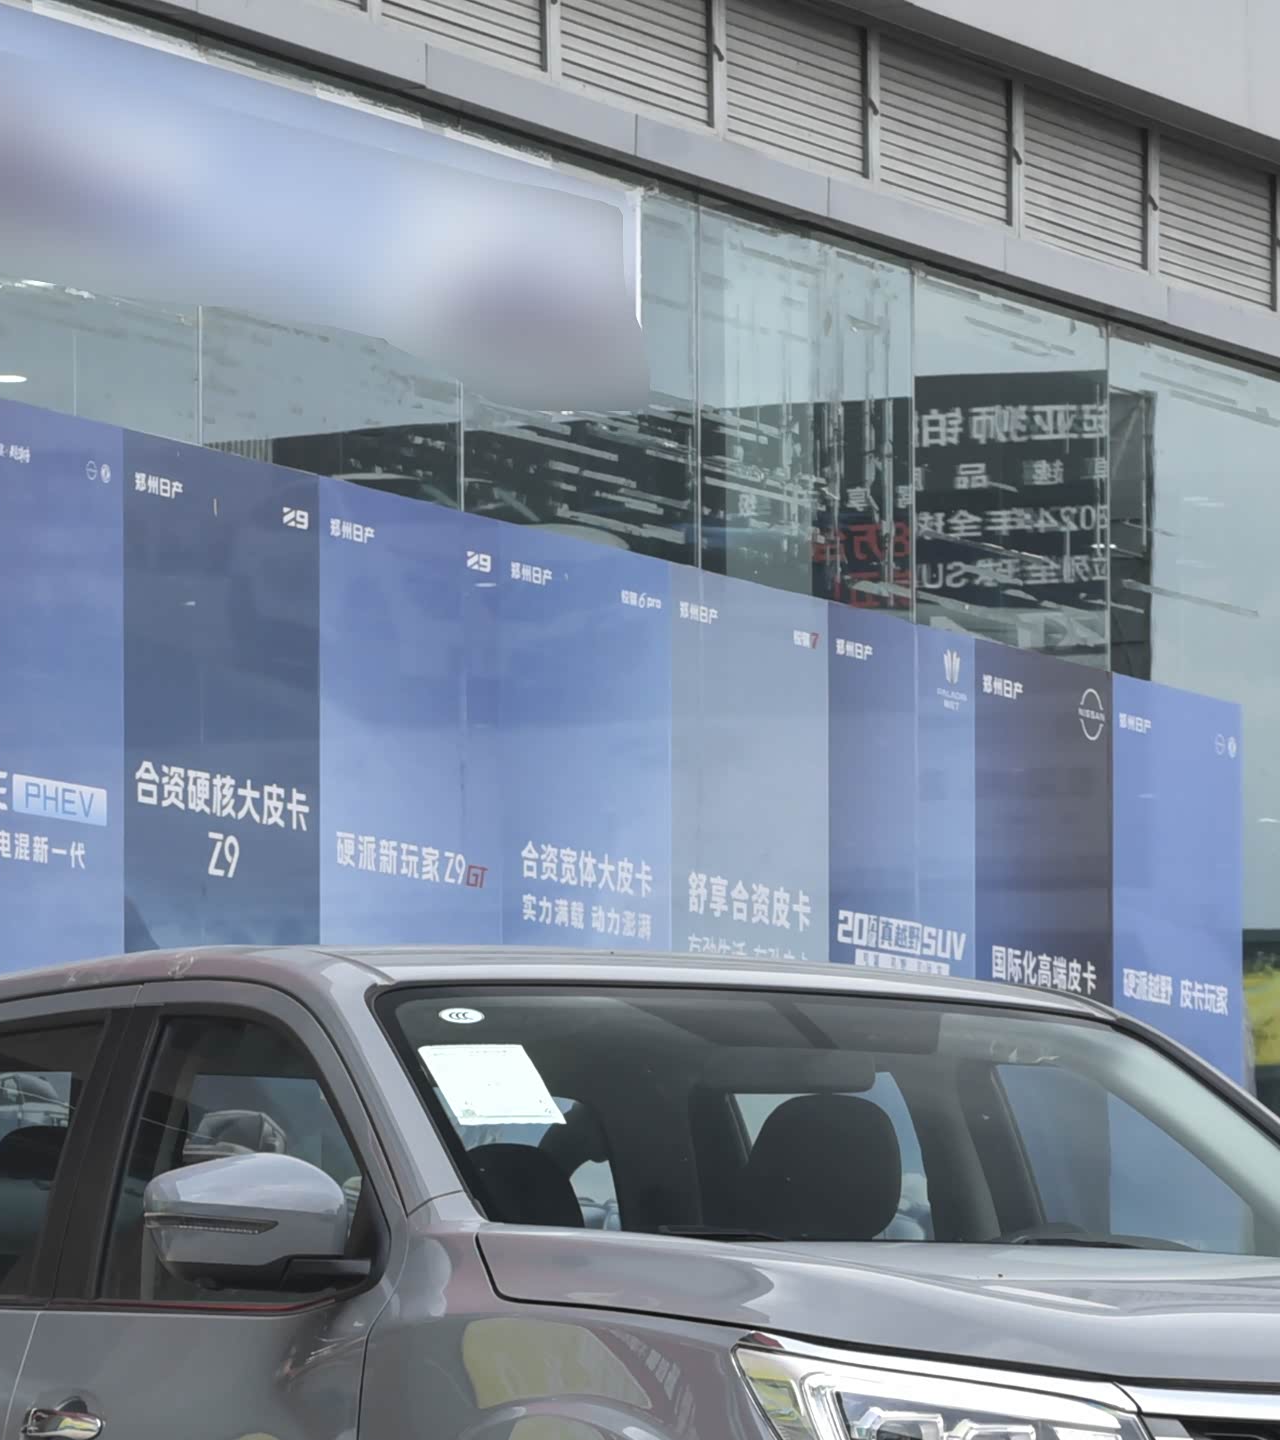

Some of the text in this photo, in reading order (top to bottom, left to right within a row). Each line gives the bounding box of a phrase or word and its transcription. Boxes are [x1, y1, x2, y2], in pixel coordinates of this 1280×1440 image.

[134, 472, 184, 499] 郑州日产
[330, 518, 375, 544] 郑州日产
[510, 561, 553, 586] 郑州日产
[679, 600, 719, 625] 郑州日产
[835, 638, 873, 661] 郑州日产
[982, 674, 1024, 700] 郑州日产
[1118, 712, 1152, 734] 郑州日产
[25, 780, 95, 818] PHEV
[135, 760, 310, 831] 合资硬核大皮卡
[208, 831, 240, 879] Z9
[521, 840, 654, 898] 合资宽体大皮卡
[521, 893, 653, 942] 实力满载 动力澎湃
[687, 871, 813, 933] 舒享合资皮卡
[991, 945, 1098, 995] 国际化高端皮卡
[1122, 967, 1229, 1016] 硬派越野 皮卡玩家
